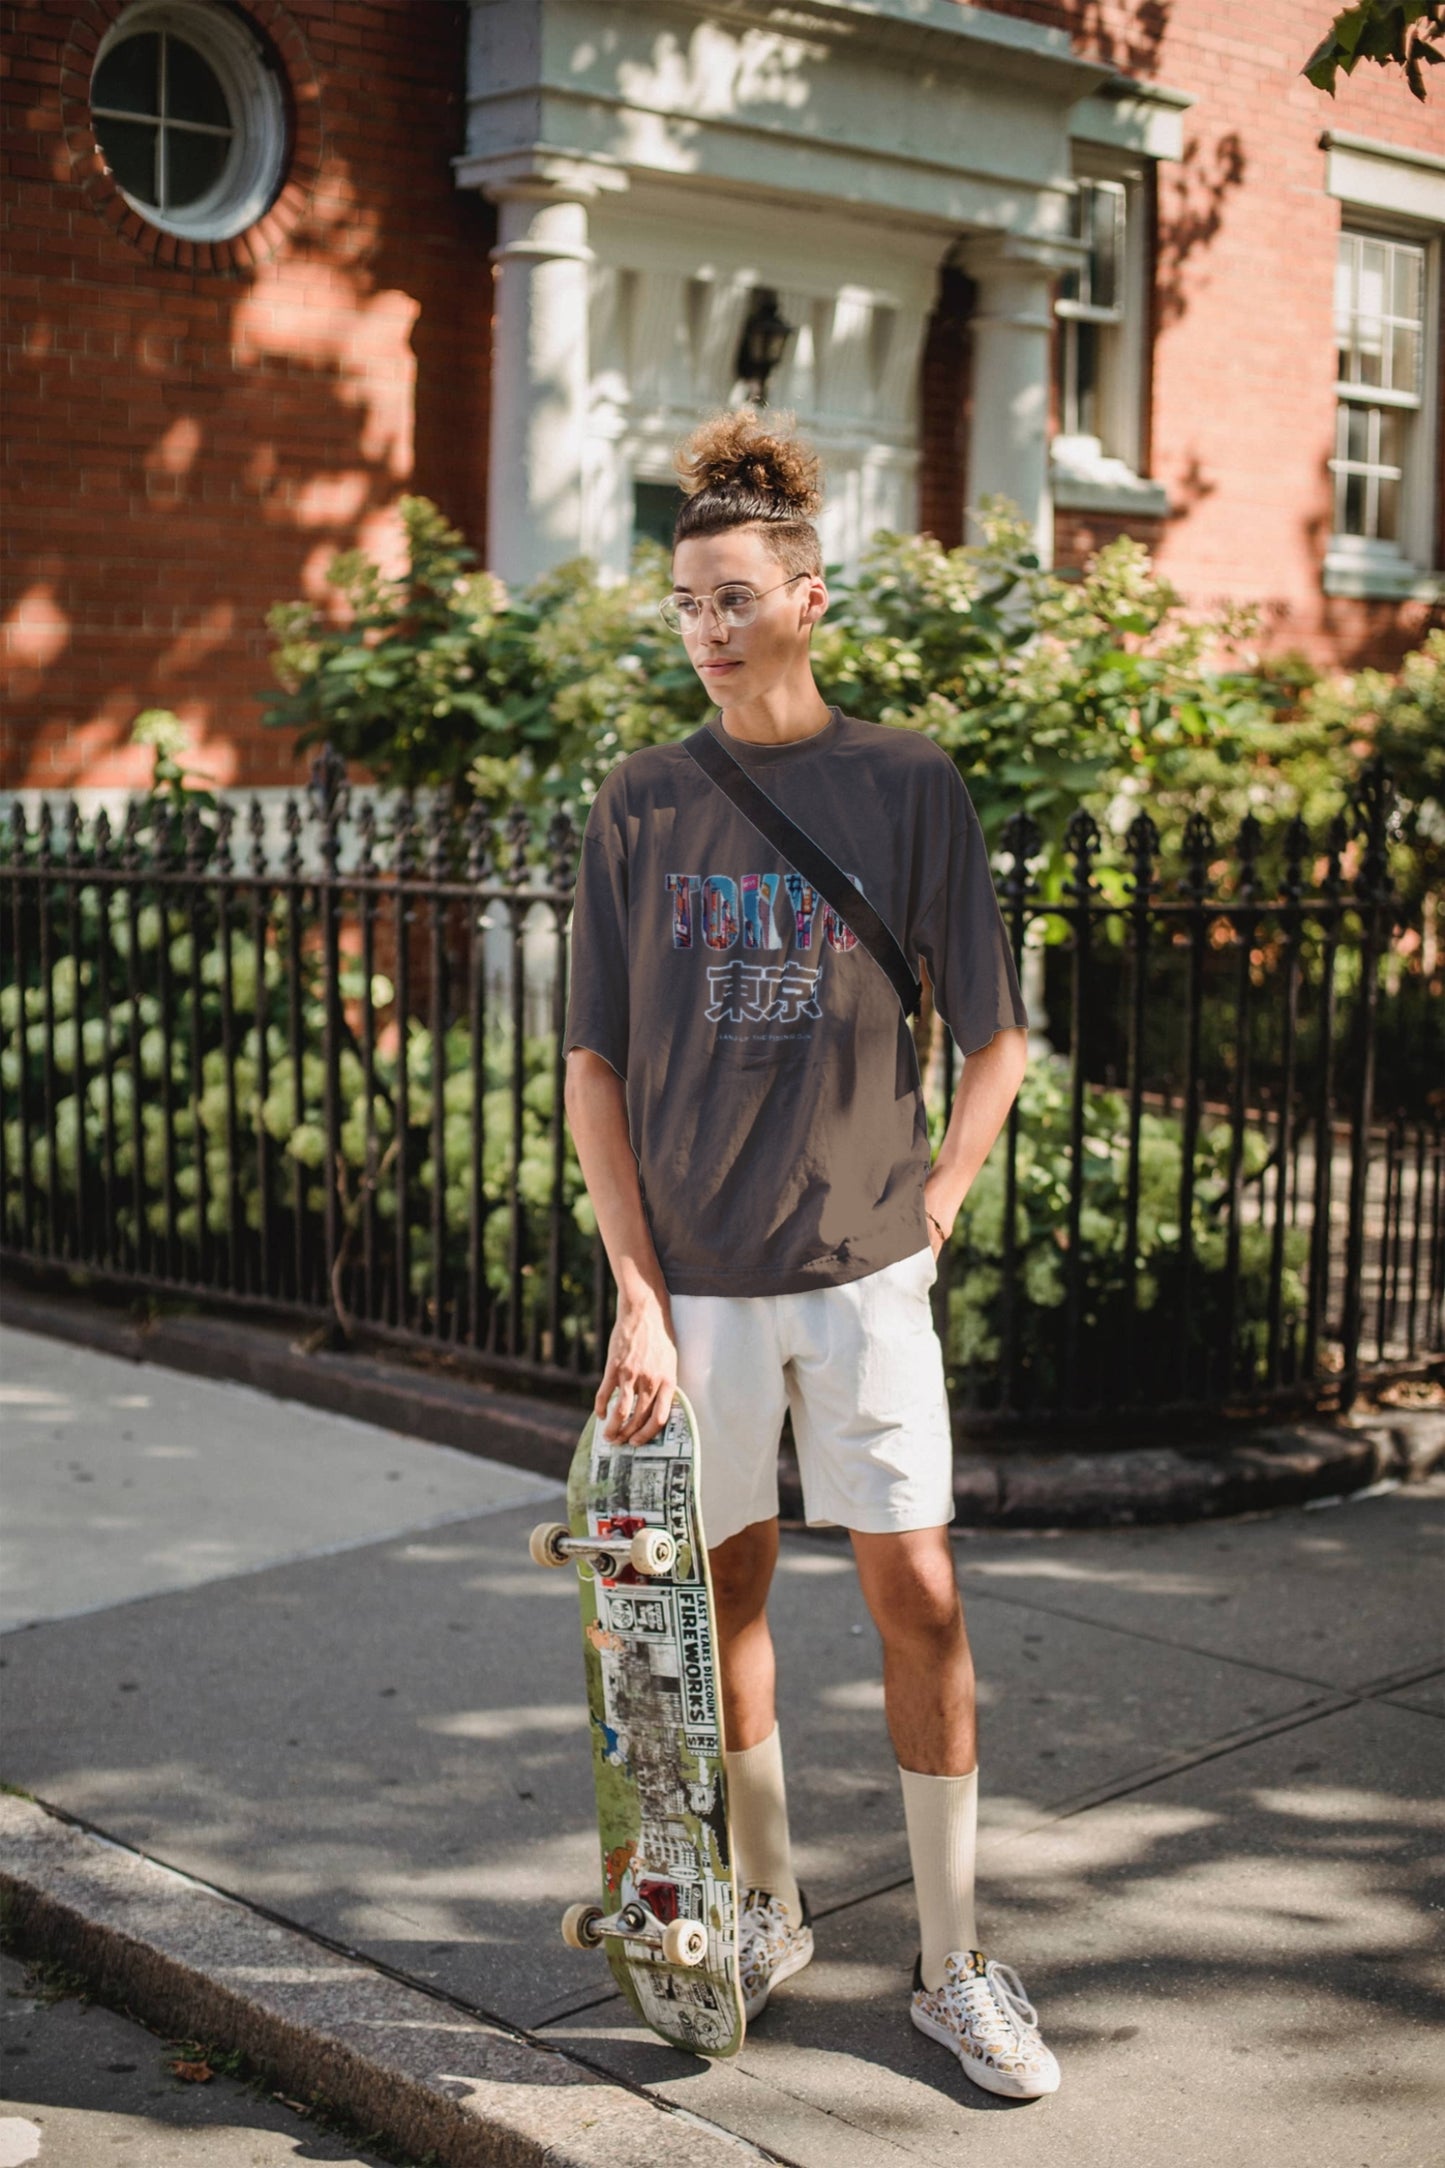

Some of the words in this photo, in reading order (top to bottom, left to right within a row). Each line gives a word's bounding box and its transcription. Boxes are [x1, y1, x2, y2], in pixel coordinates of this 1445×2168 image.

[704, 960, 823, 1023] 東京
[671, 1474, 690, 1570] TATT
[696, 1593, 707, 1621] LAST
[680, 1593, 705, 1721] FIREWORKS
[700, 1626, 712, 1662] YEARS
[703, 1666, 716, 1719] DISCOUNT
[687, 1736, 719, 1748] RKS
